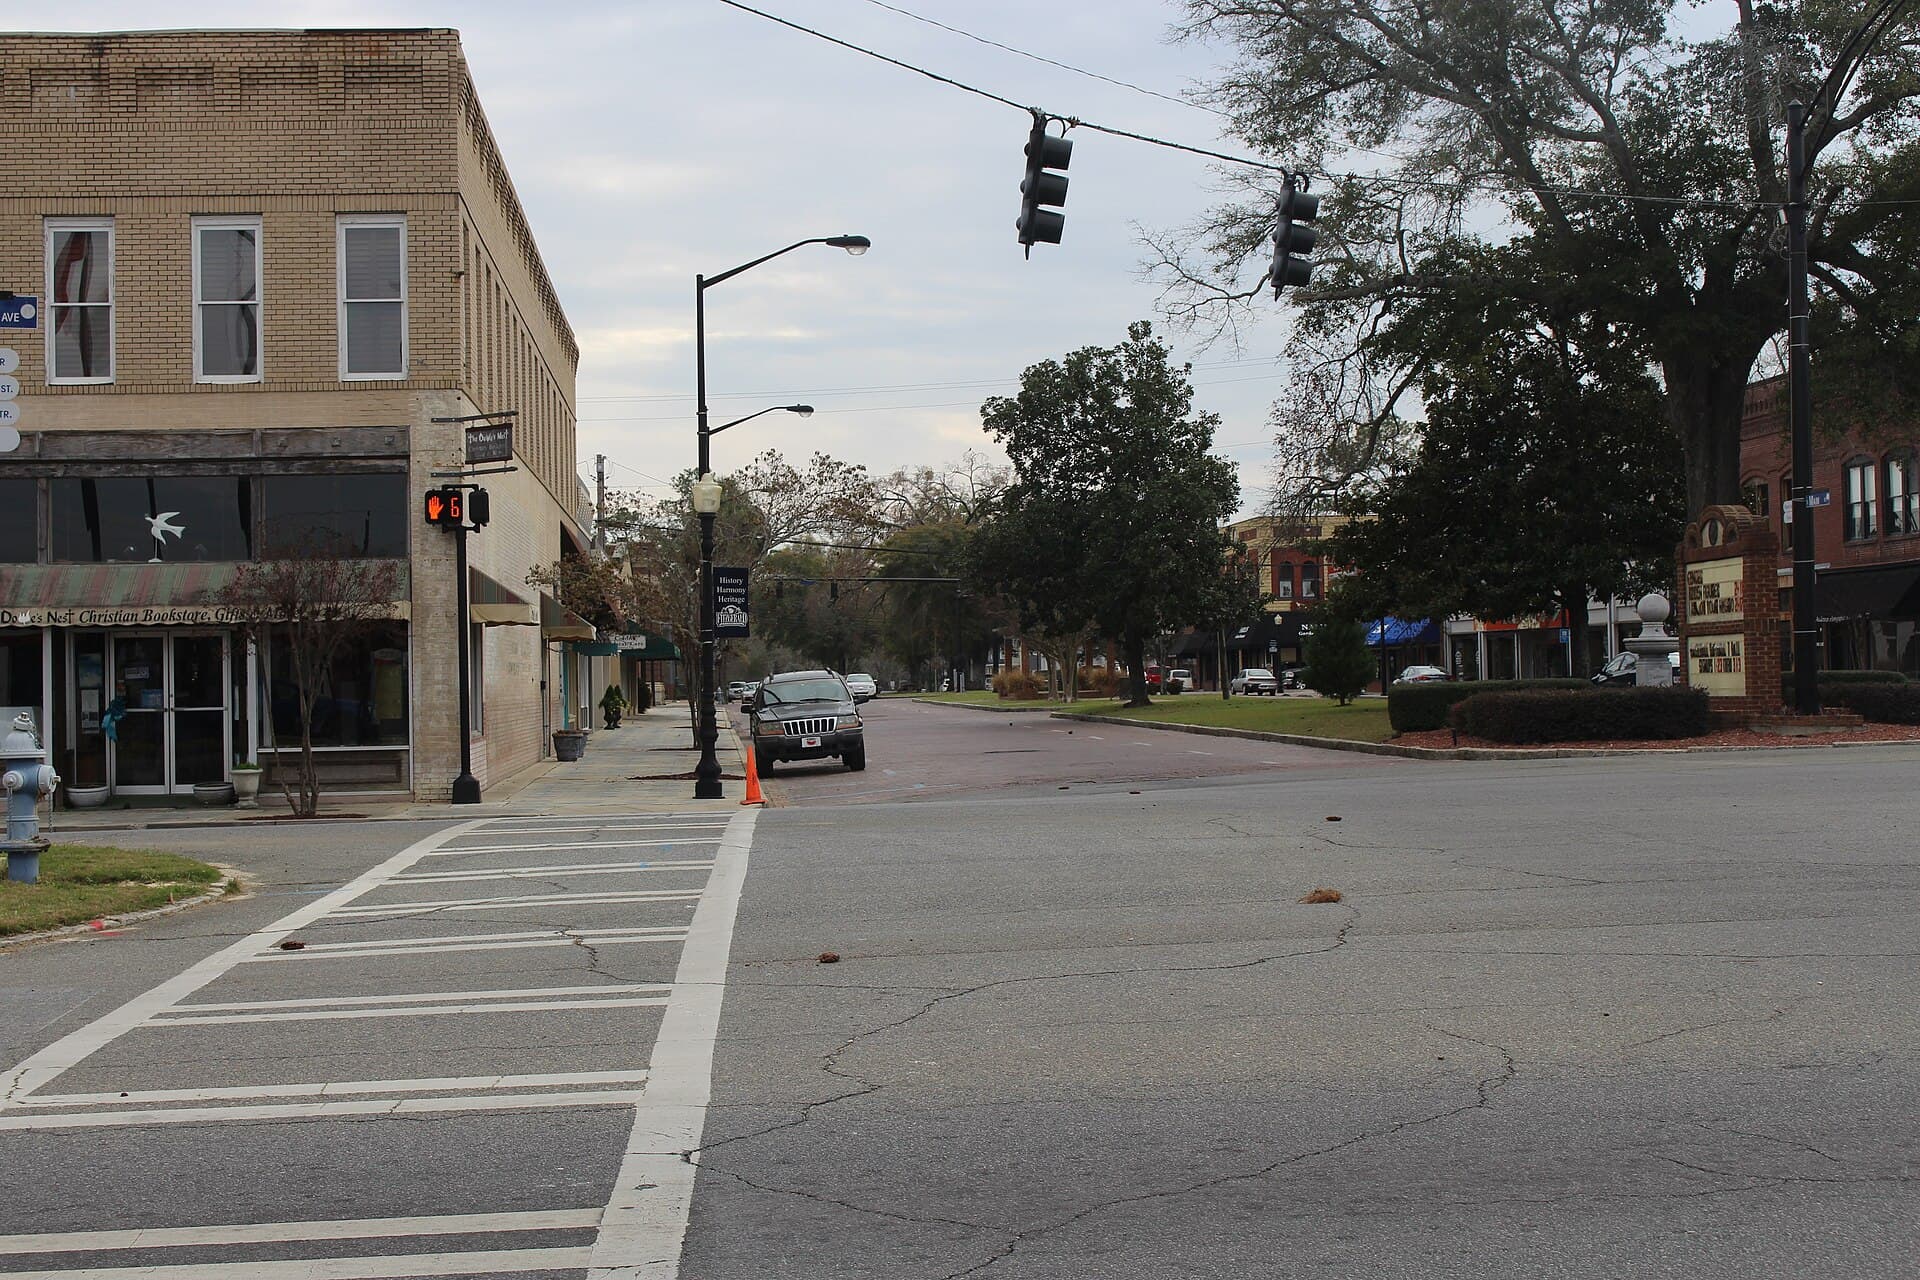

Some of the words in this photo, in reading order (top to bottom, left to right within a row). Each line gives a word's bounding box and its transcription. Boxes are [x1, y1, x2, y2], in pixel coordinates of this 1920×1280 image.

[1, 312, 20, 323] AVE
[451, 497, 460, 517] 6
[719, 576, 744, 586] History
[716, 585, 746, 595] Harmony
[718, 595, 745, 604] Heritage
[1, 609, 42, 624] Doe's
[47, 608, 74, 624] Nest
[79, 608, 140, 624] Christian
